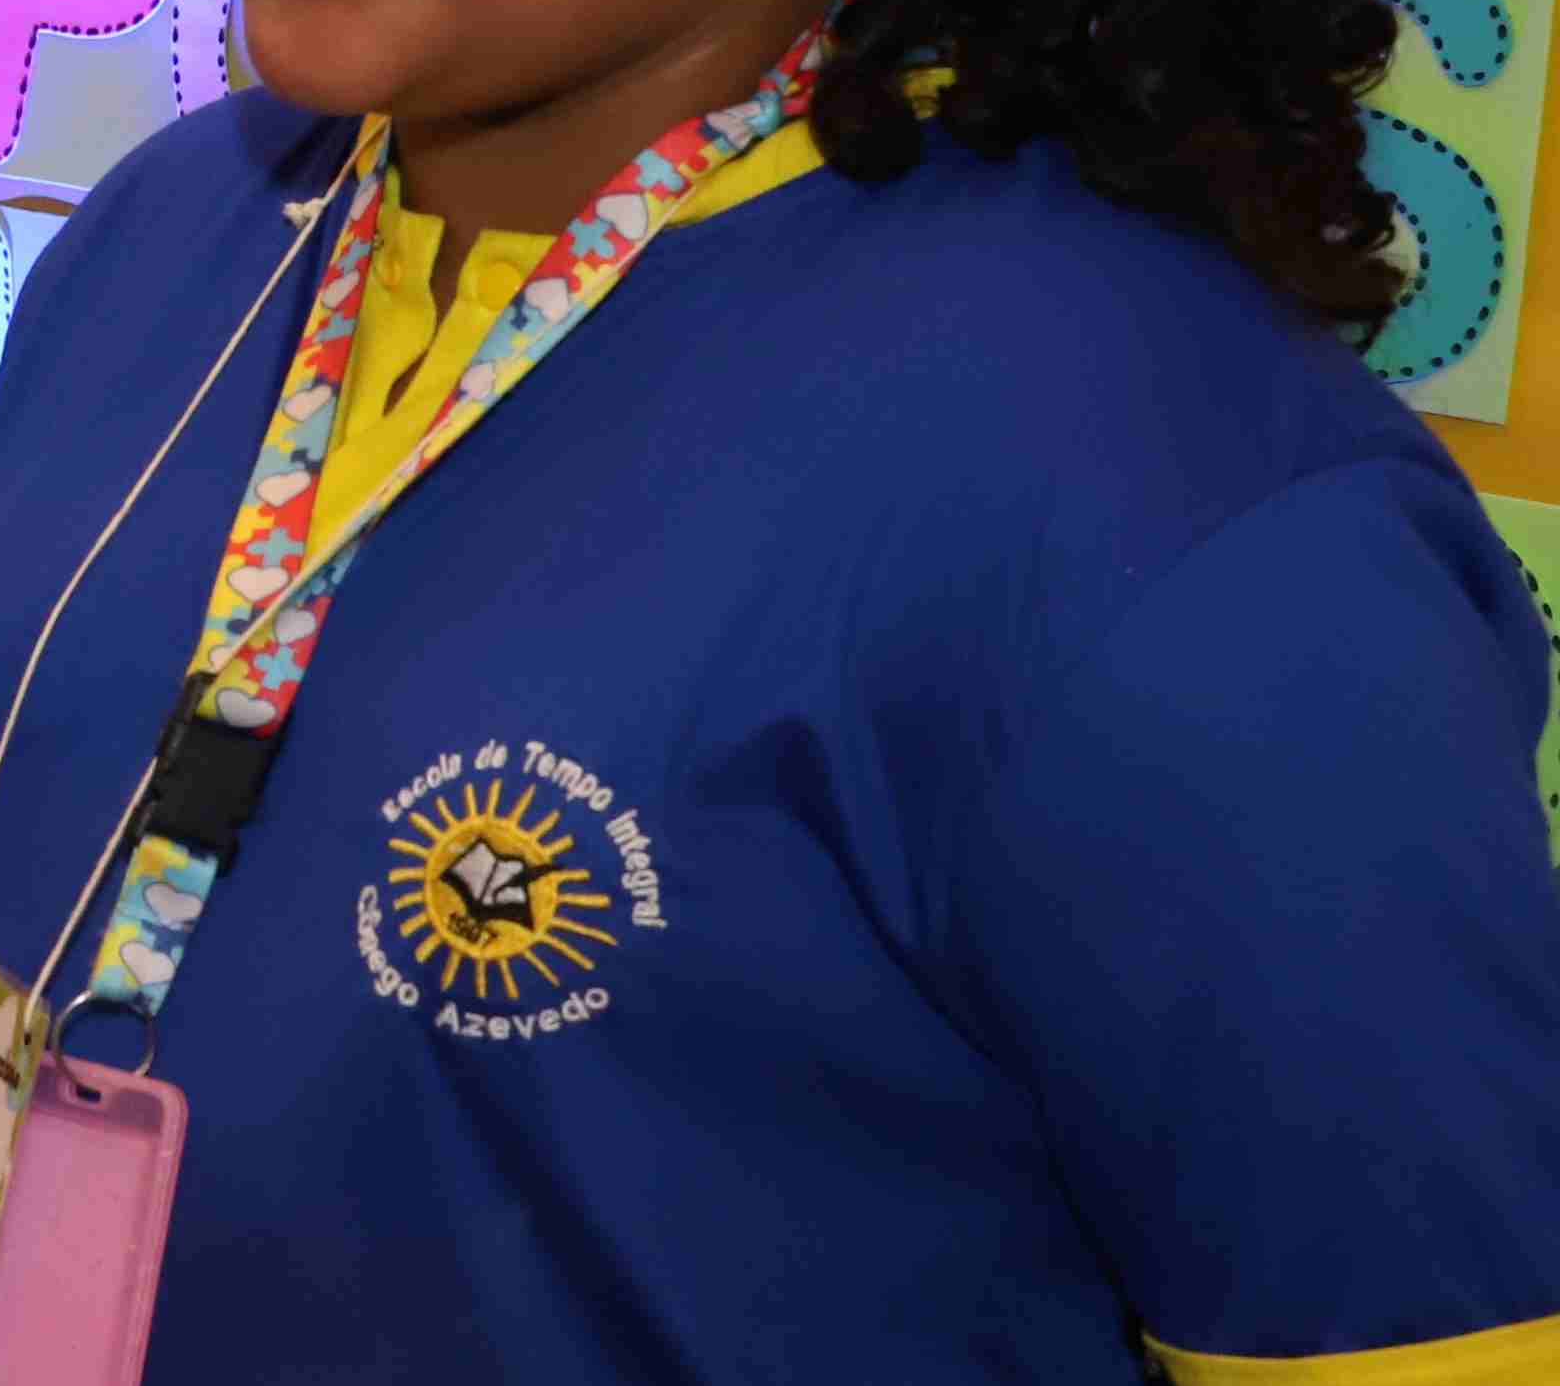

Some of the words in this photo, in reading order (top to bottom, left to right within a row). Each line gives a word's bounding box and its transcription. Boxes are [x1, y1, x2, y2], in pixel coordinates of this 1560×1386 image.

[382, 752, 461, 823] Escola
[474, 740, 508, 771] de
[523, 740, 614, 811] Tempo
[605, 809, 668, 929] Integral
[435, 988, 610, 1040] Azevedo
